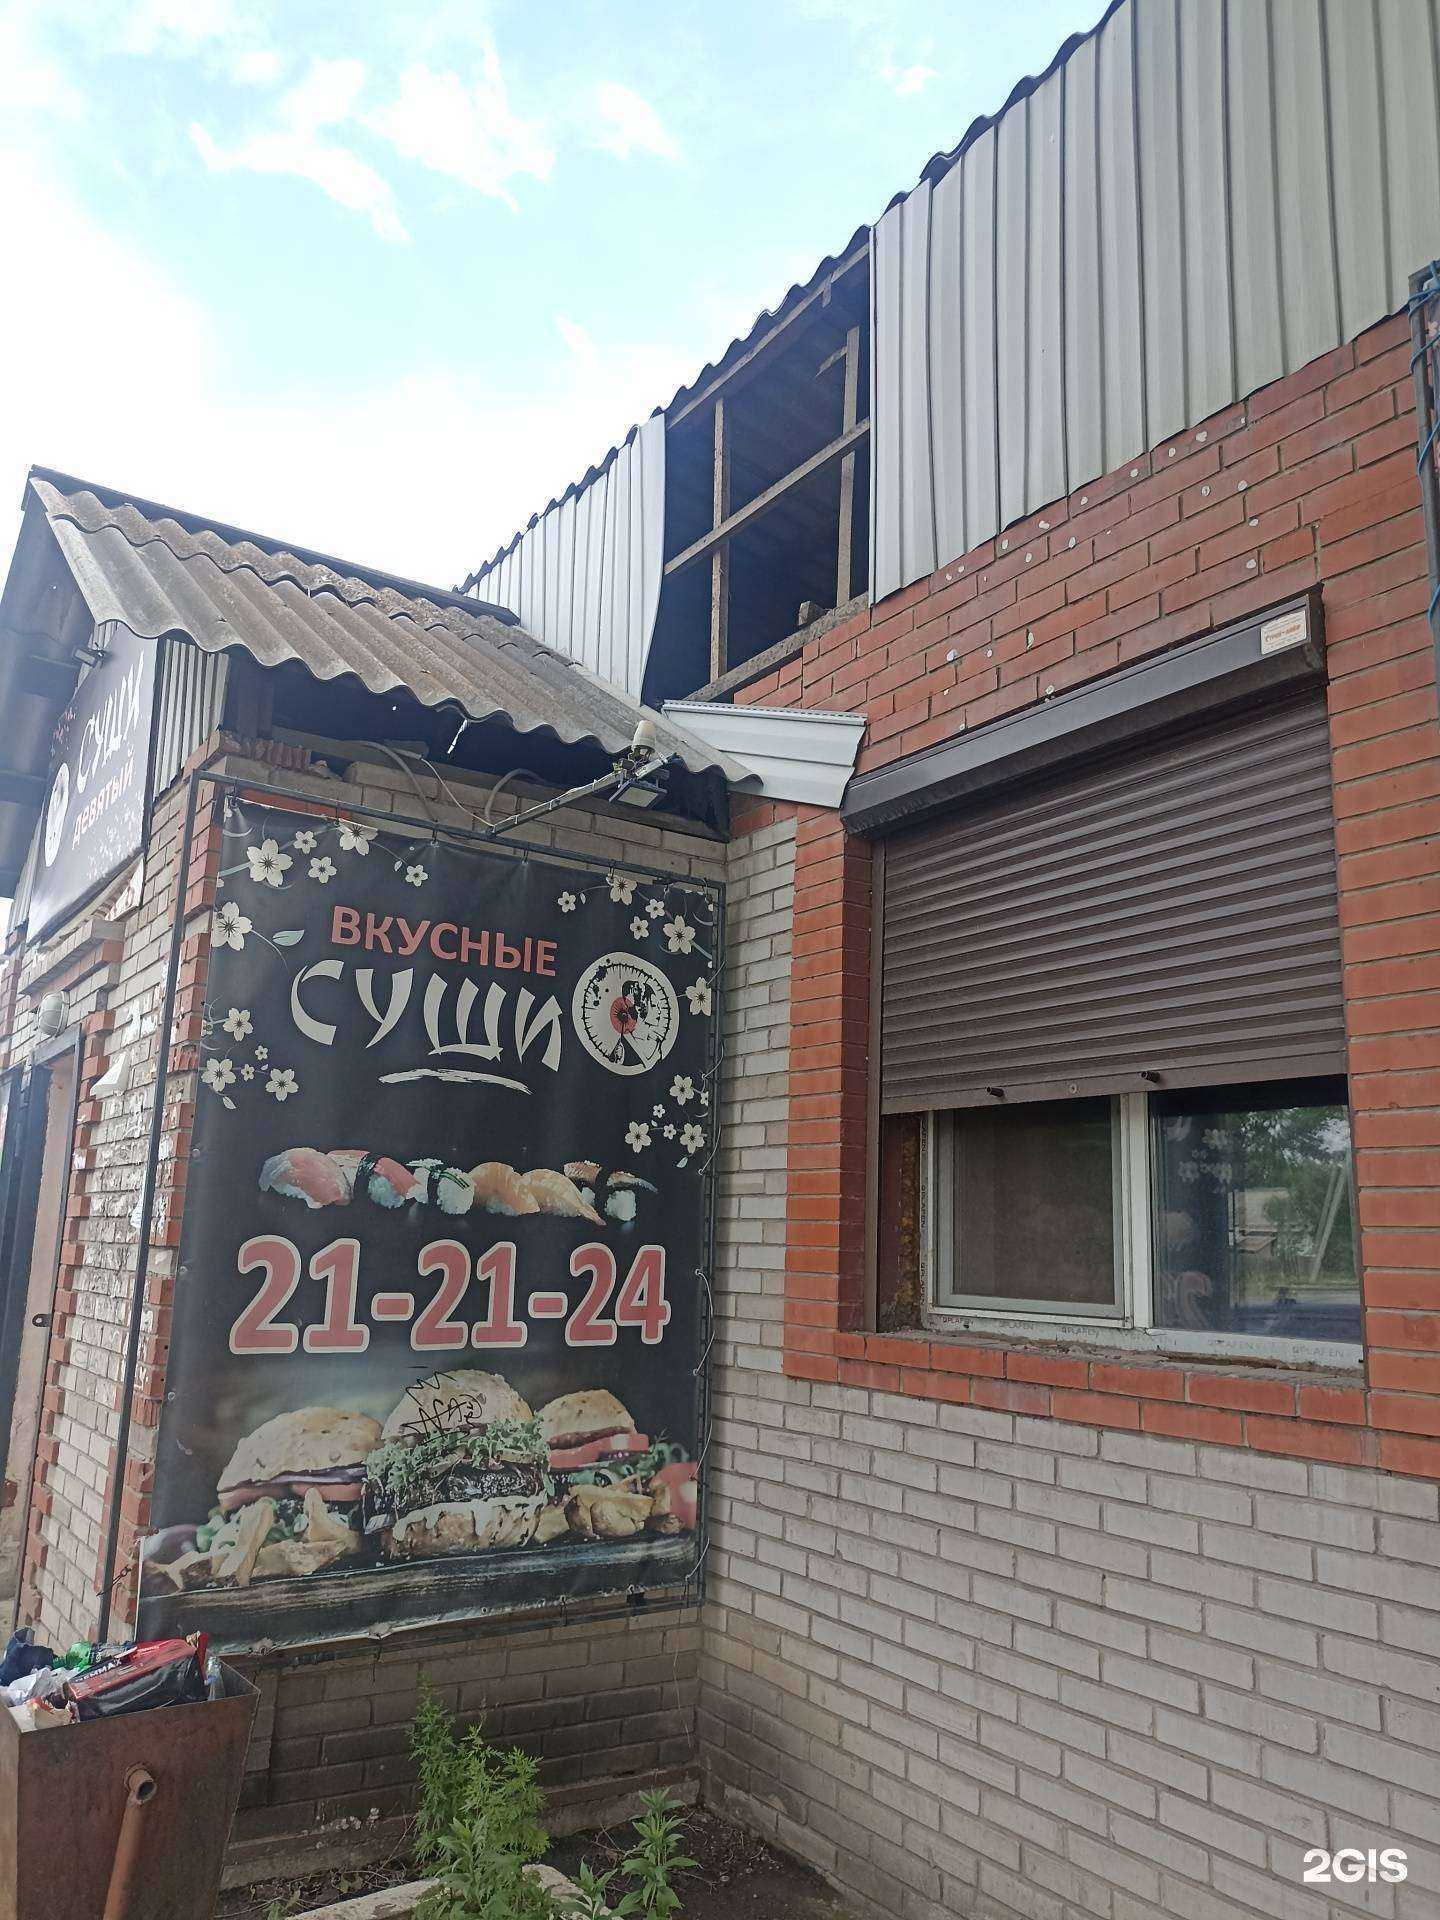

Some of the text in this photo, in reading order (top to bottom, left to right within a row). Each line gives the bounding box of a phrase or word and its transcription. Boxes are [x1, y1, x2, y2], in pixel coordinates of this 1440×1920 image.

[76, 650, 144, 794] СУШИ
[331, 905, 558, 977] ВКУСНЫЕ
[290, 959, 563, 1072] СУШИ
[229, 1234, 671, 1354] 21-21-24
